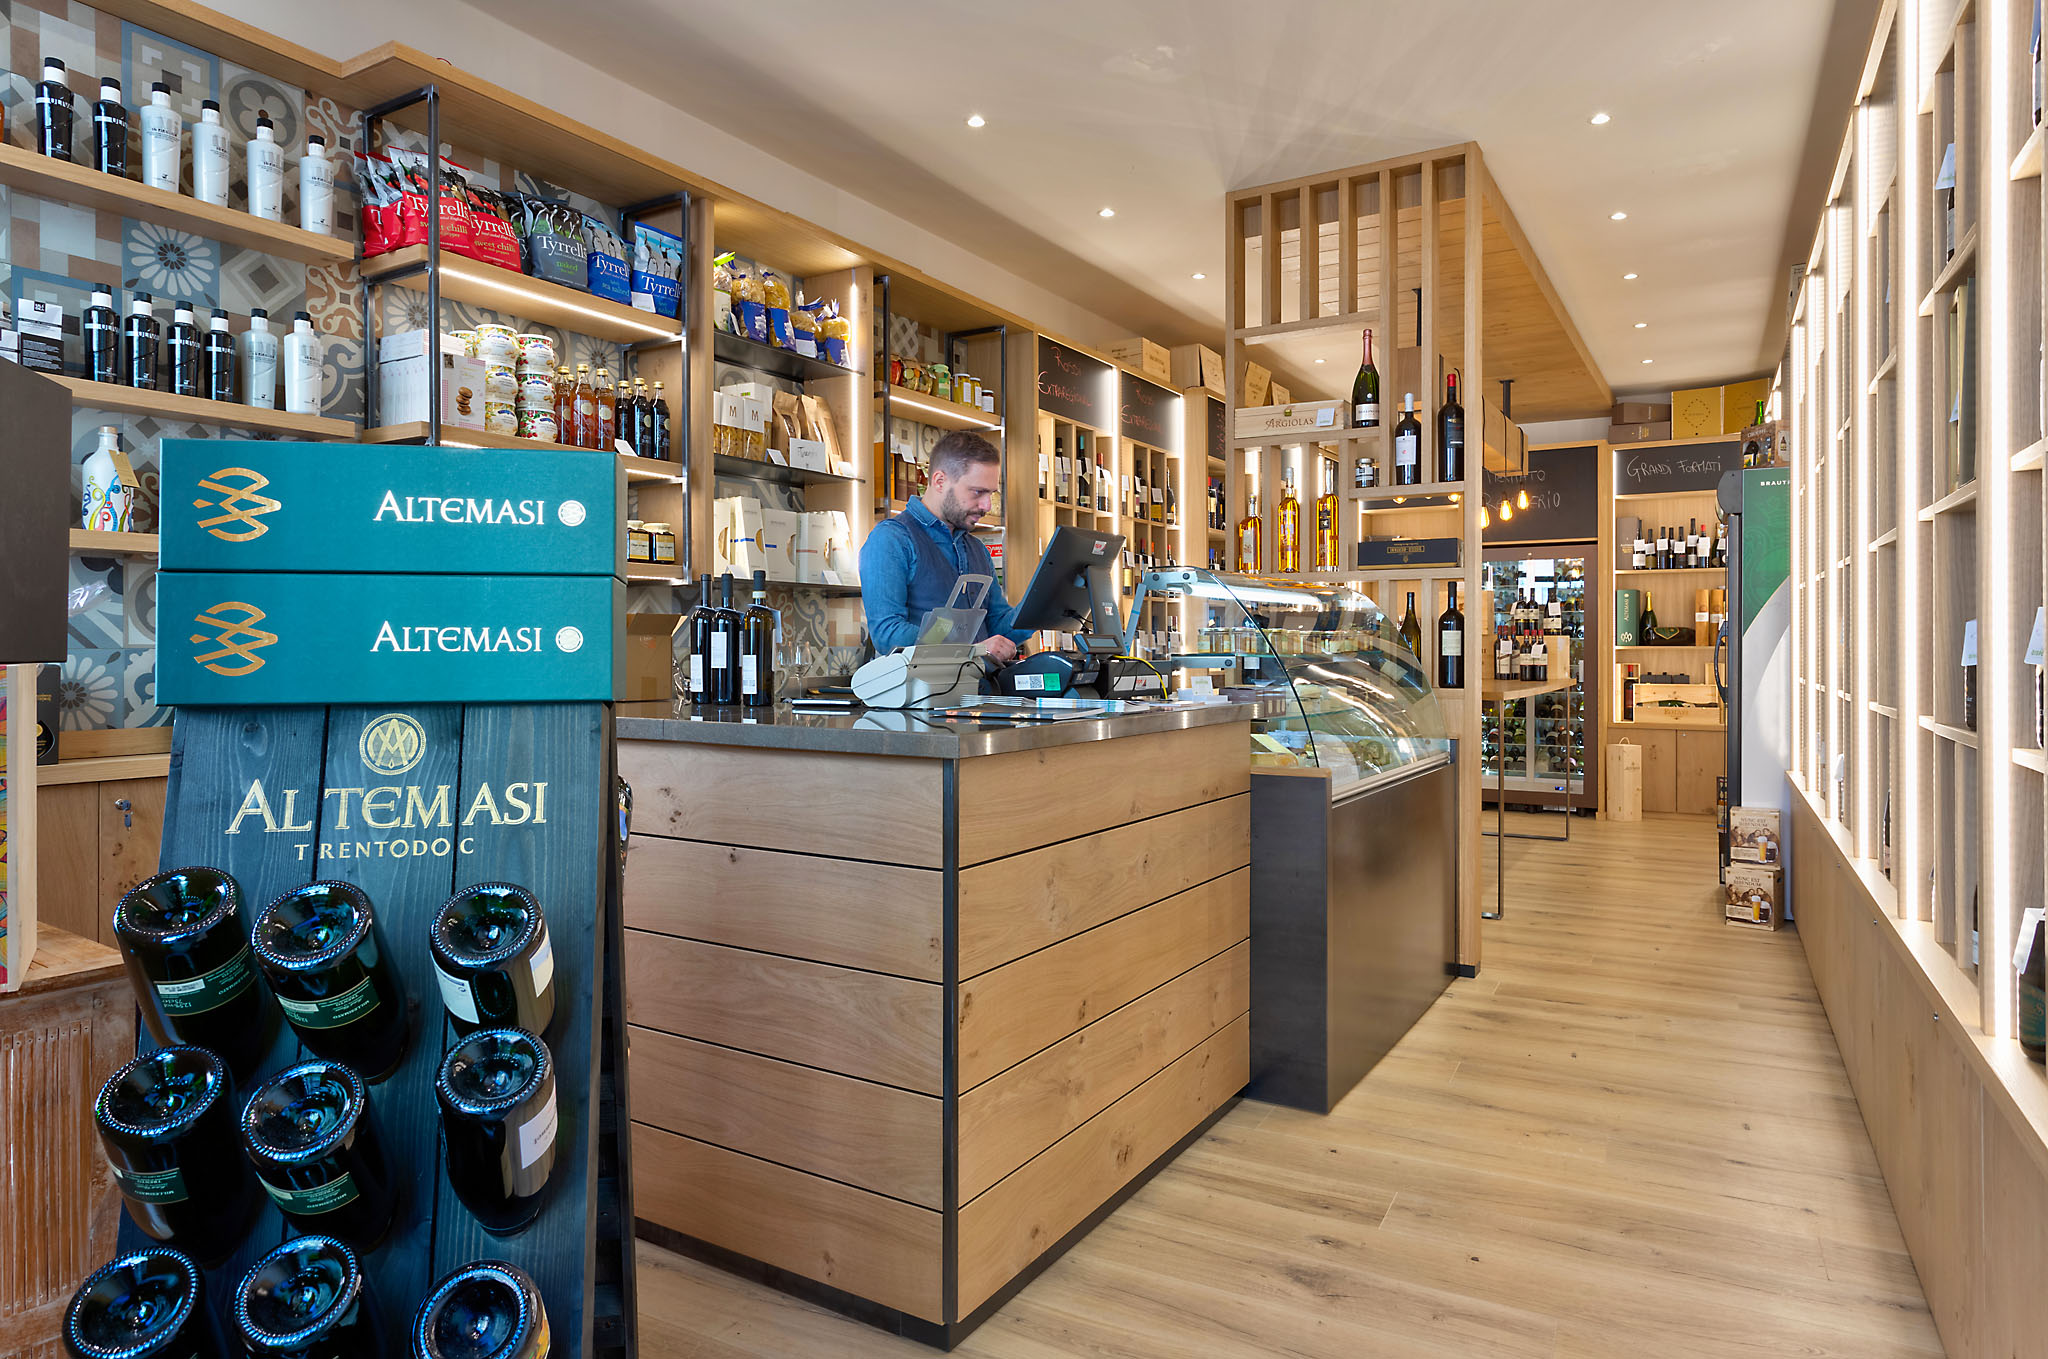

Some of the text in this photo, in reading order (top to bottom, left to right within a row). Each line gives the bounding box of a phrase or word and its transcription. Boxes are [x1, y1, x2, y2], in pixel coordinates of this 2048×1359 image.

[407, 194, 470, 221] Tyrell's
[1265, 417, 1314, 431] ARGIOLAS
[373, 490, 545, 525] ALTEMASI
[370, 620, 542, 652] ALTEMASI
